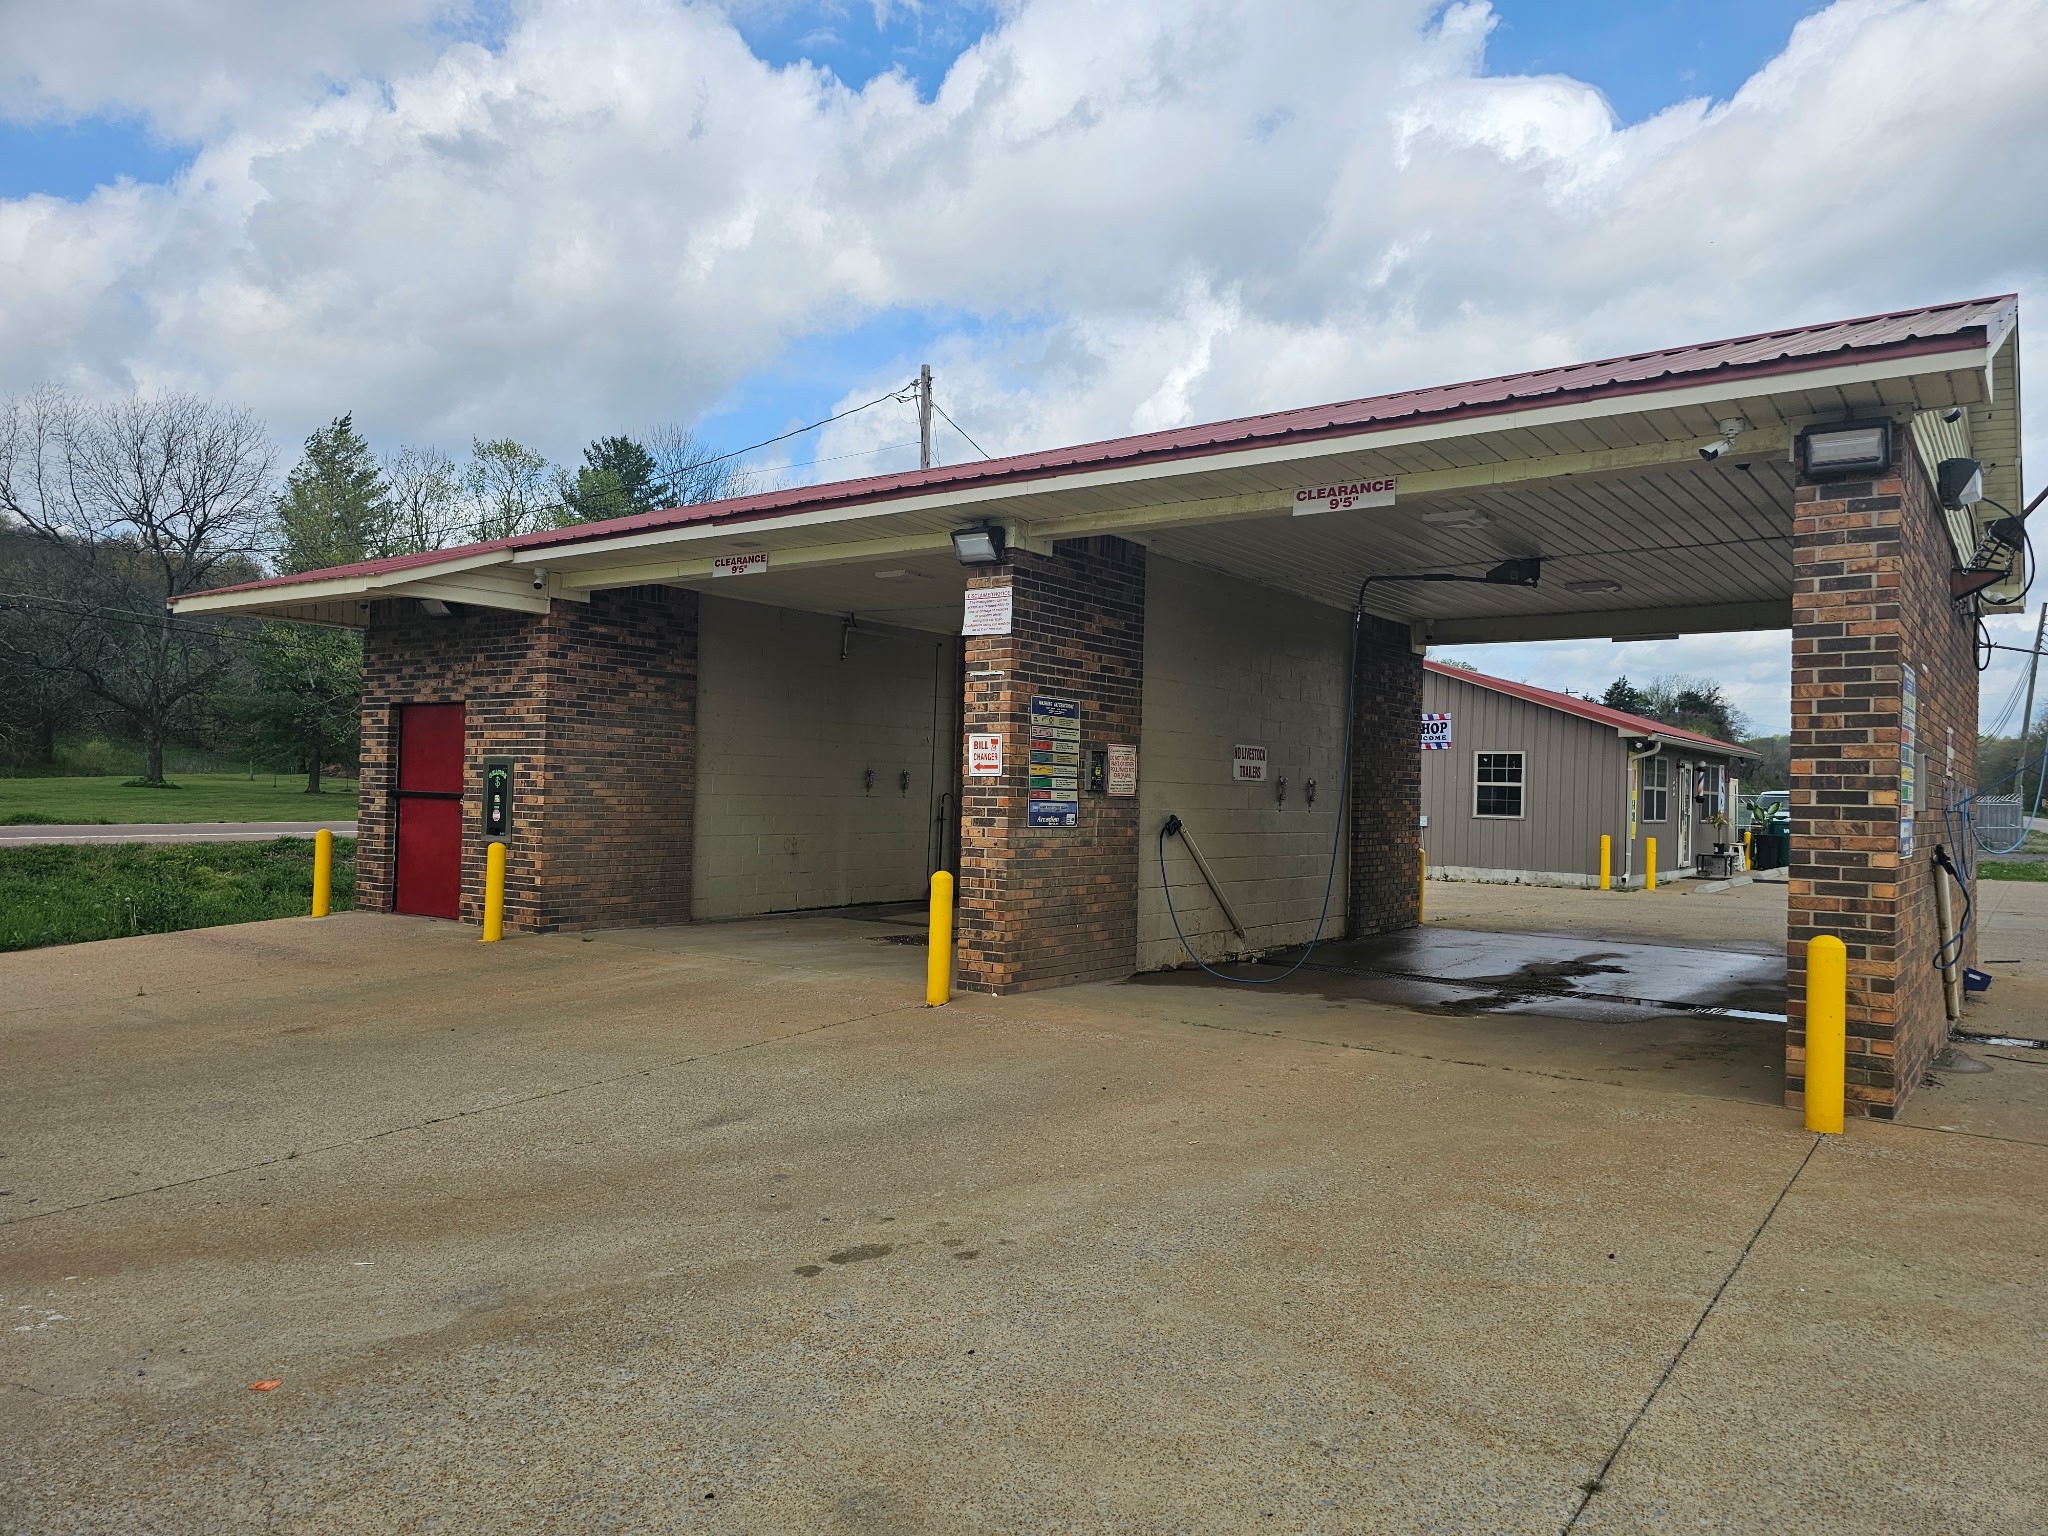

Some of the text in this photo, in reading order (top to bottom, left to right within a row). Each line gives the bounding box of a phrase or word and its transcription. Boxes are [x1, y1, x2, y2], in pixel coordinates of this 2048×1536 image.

[1296, 479, 1395, 502] CLEARANCE
[1329, 495, 1359, 510] 9'5"
[714, 554, 767, 567] CLEARANCE
[973, 740, 988, 750] BILL
[1234, 746, 1266, 761] NO LIVESTOCK
[1239, 765, 1261, 778] TRAILERS
